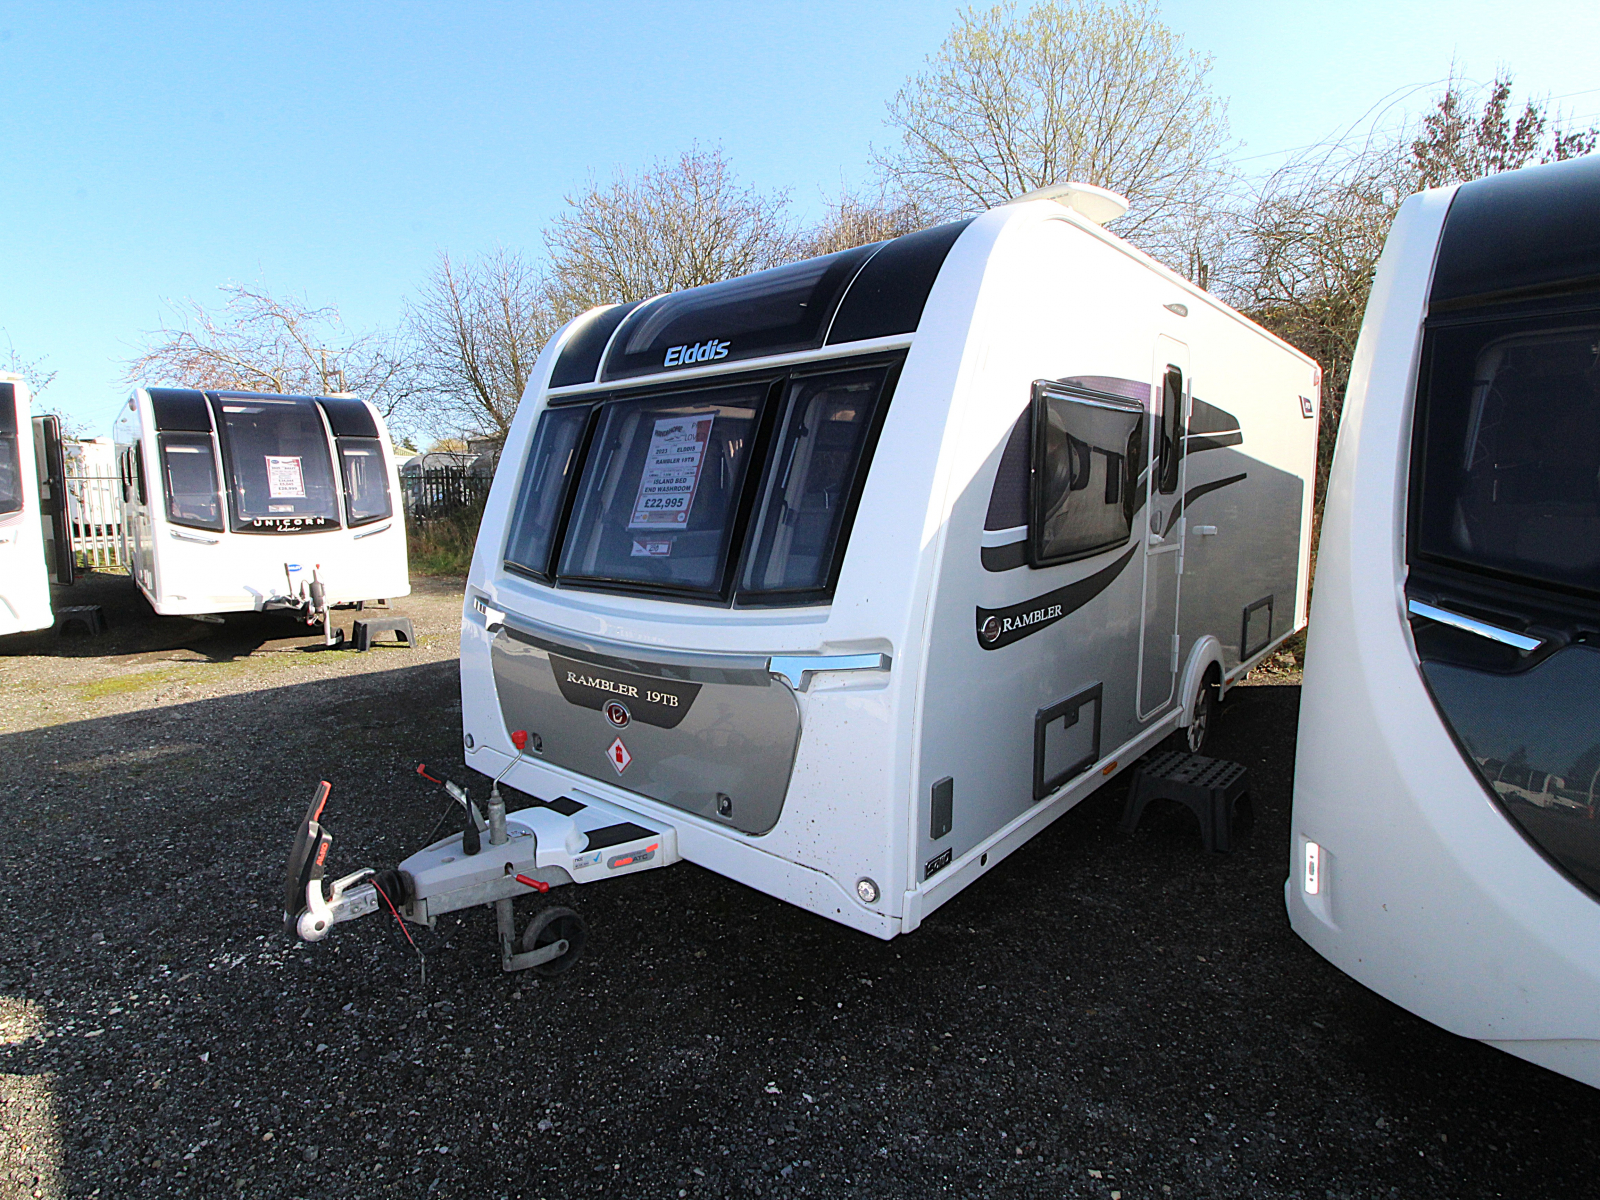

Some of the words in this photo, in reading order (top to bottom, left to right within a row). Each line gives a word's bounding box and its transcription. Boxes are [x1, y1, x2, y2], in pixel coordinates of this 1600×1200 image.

[664, 339, 731, 367] Elddis
[676, 445, 696, 453] ELDDIS
[655, 457, 680, 465] RAMBLER
[644, 498, 684, 509] £22,995
[253, 518, 325, 526] UNICORN
[1002, 604, 1063, 633] RAMBLER
[566, 671, 639, 699] RAMBLER
[645, 690, 679, 707] 19TB
[633, 853, 648, 861] ATC
